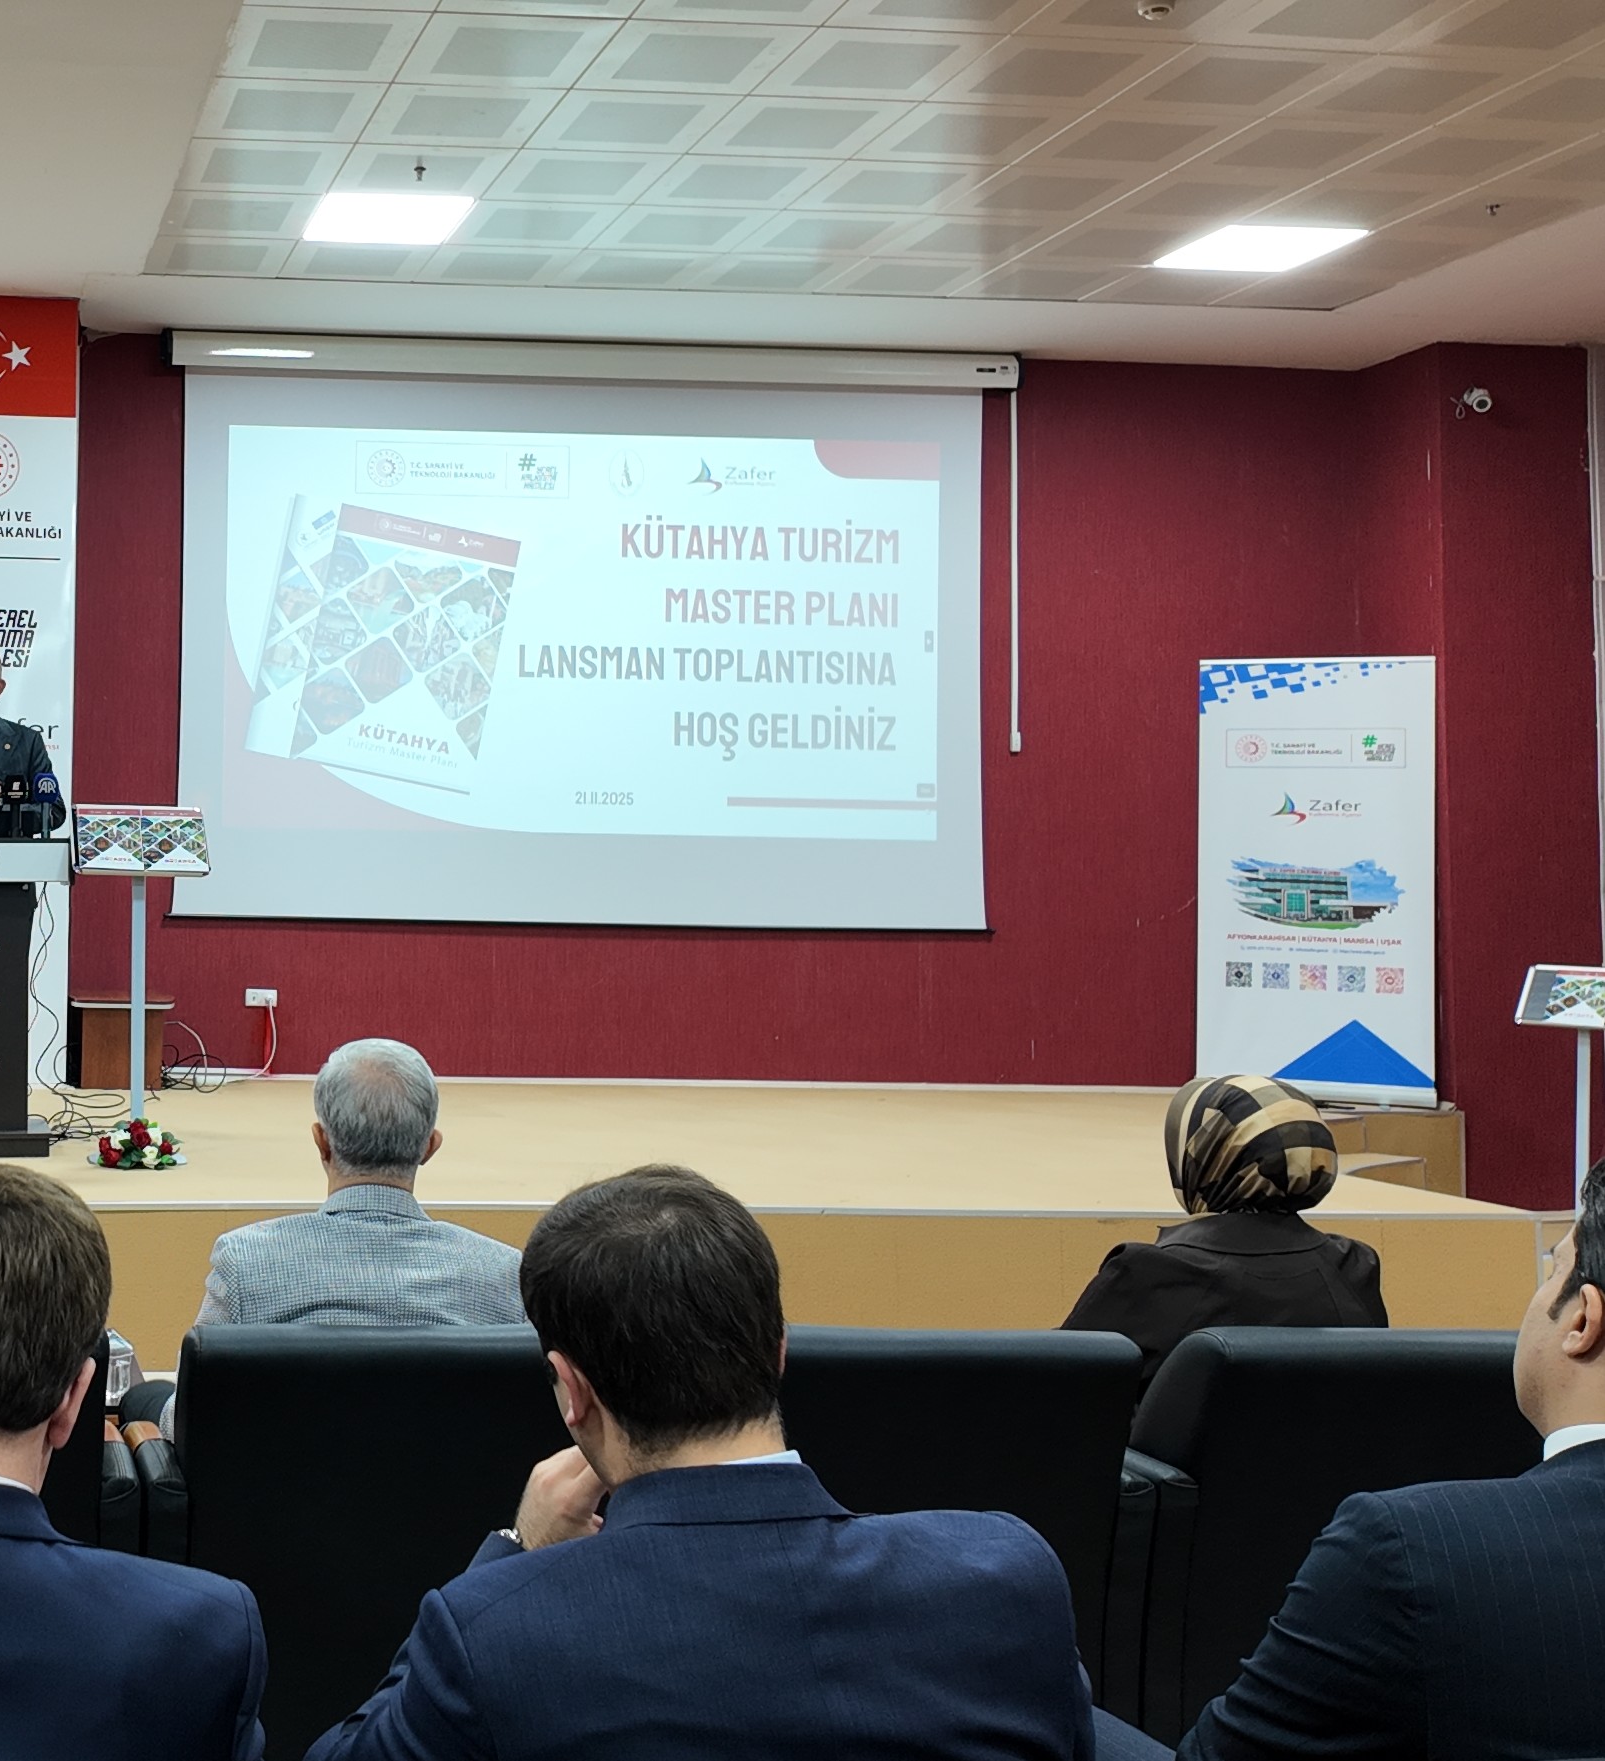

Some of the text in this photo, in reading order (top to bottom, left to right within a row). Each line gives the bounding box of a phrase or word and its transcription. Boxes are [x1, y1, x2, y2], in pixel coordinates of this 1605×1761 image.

[724, 466, 777, 481] Zafer
[14, 511, 32, 523] VE
[621, 514, 900, 564] KÜTAHYA TURİZM
[665, 587, 899, 628] MASTER PLANI
[518, 644, 897, 686] LANSMAN TOPLANTISINA
[358, 723, 450, 755] KÜTAHYA
[673, 705, 896, 762] HOŞ GELDİNİZ
[389, 746, 427, 762] Master
[1309, 799, 1362, 812] Zafer
